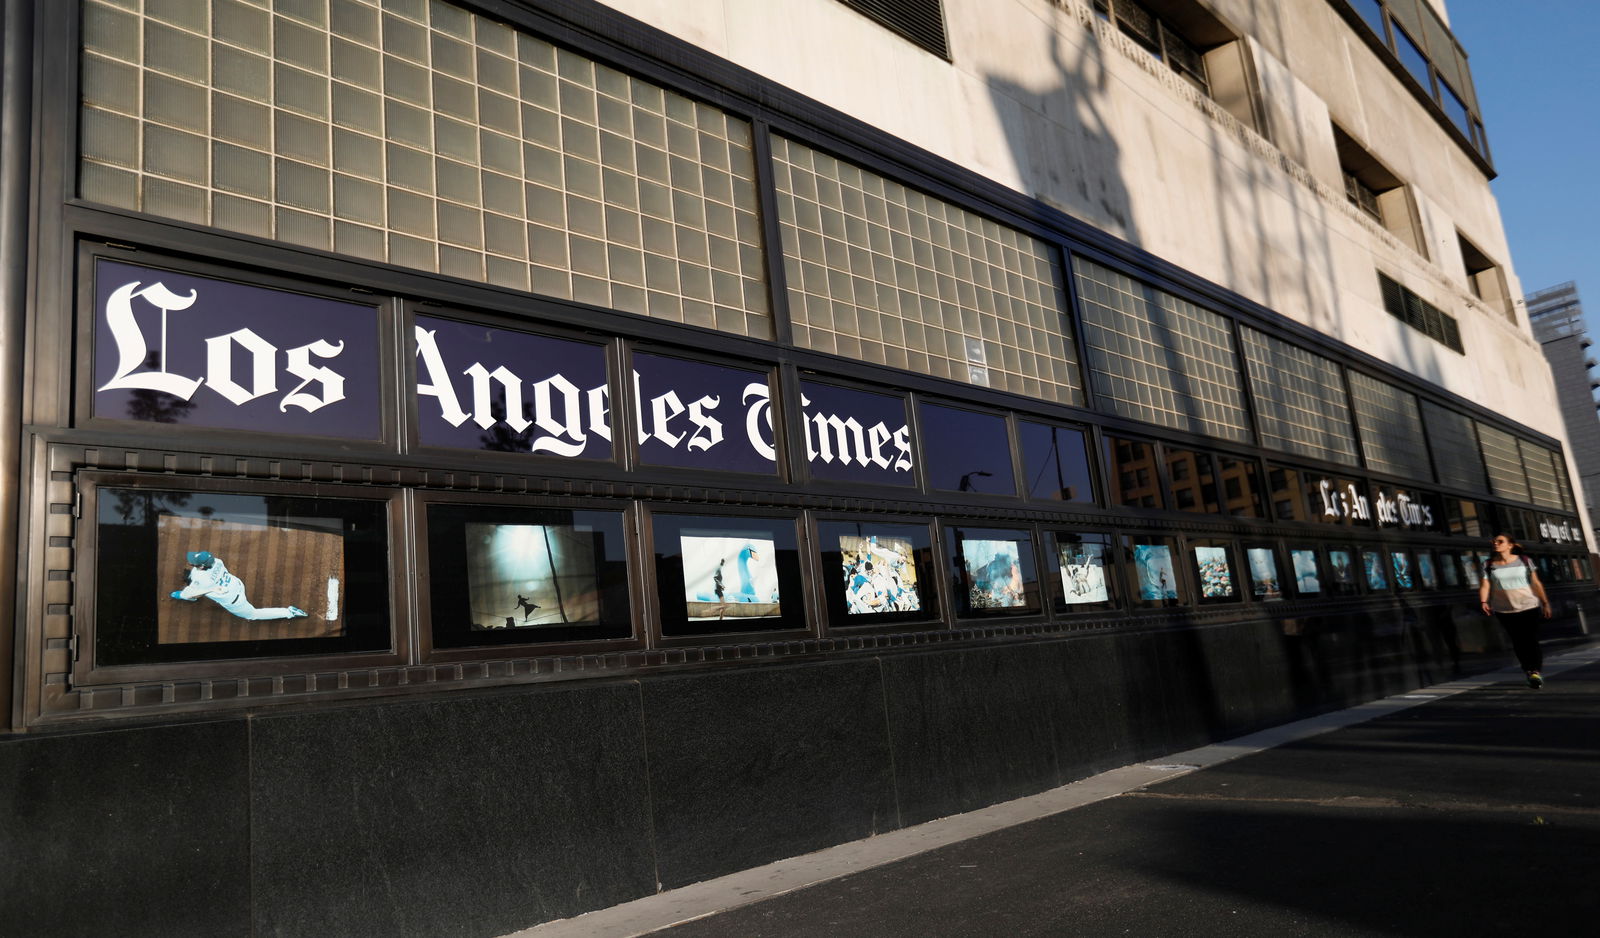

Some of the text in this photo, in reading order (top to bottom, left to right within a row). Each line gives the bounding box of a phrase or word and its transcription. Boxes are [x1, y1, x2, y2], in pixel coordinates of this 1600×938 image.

[97, 281, 913, 473] Los Angeles Times
